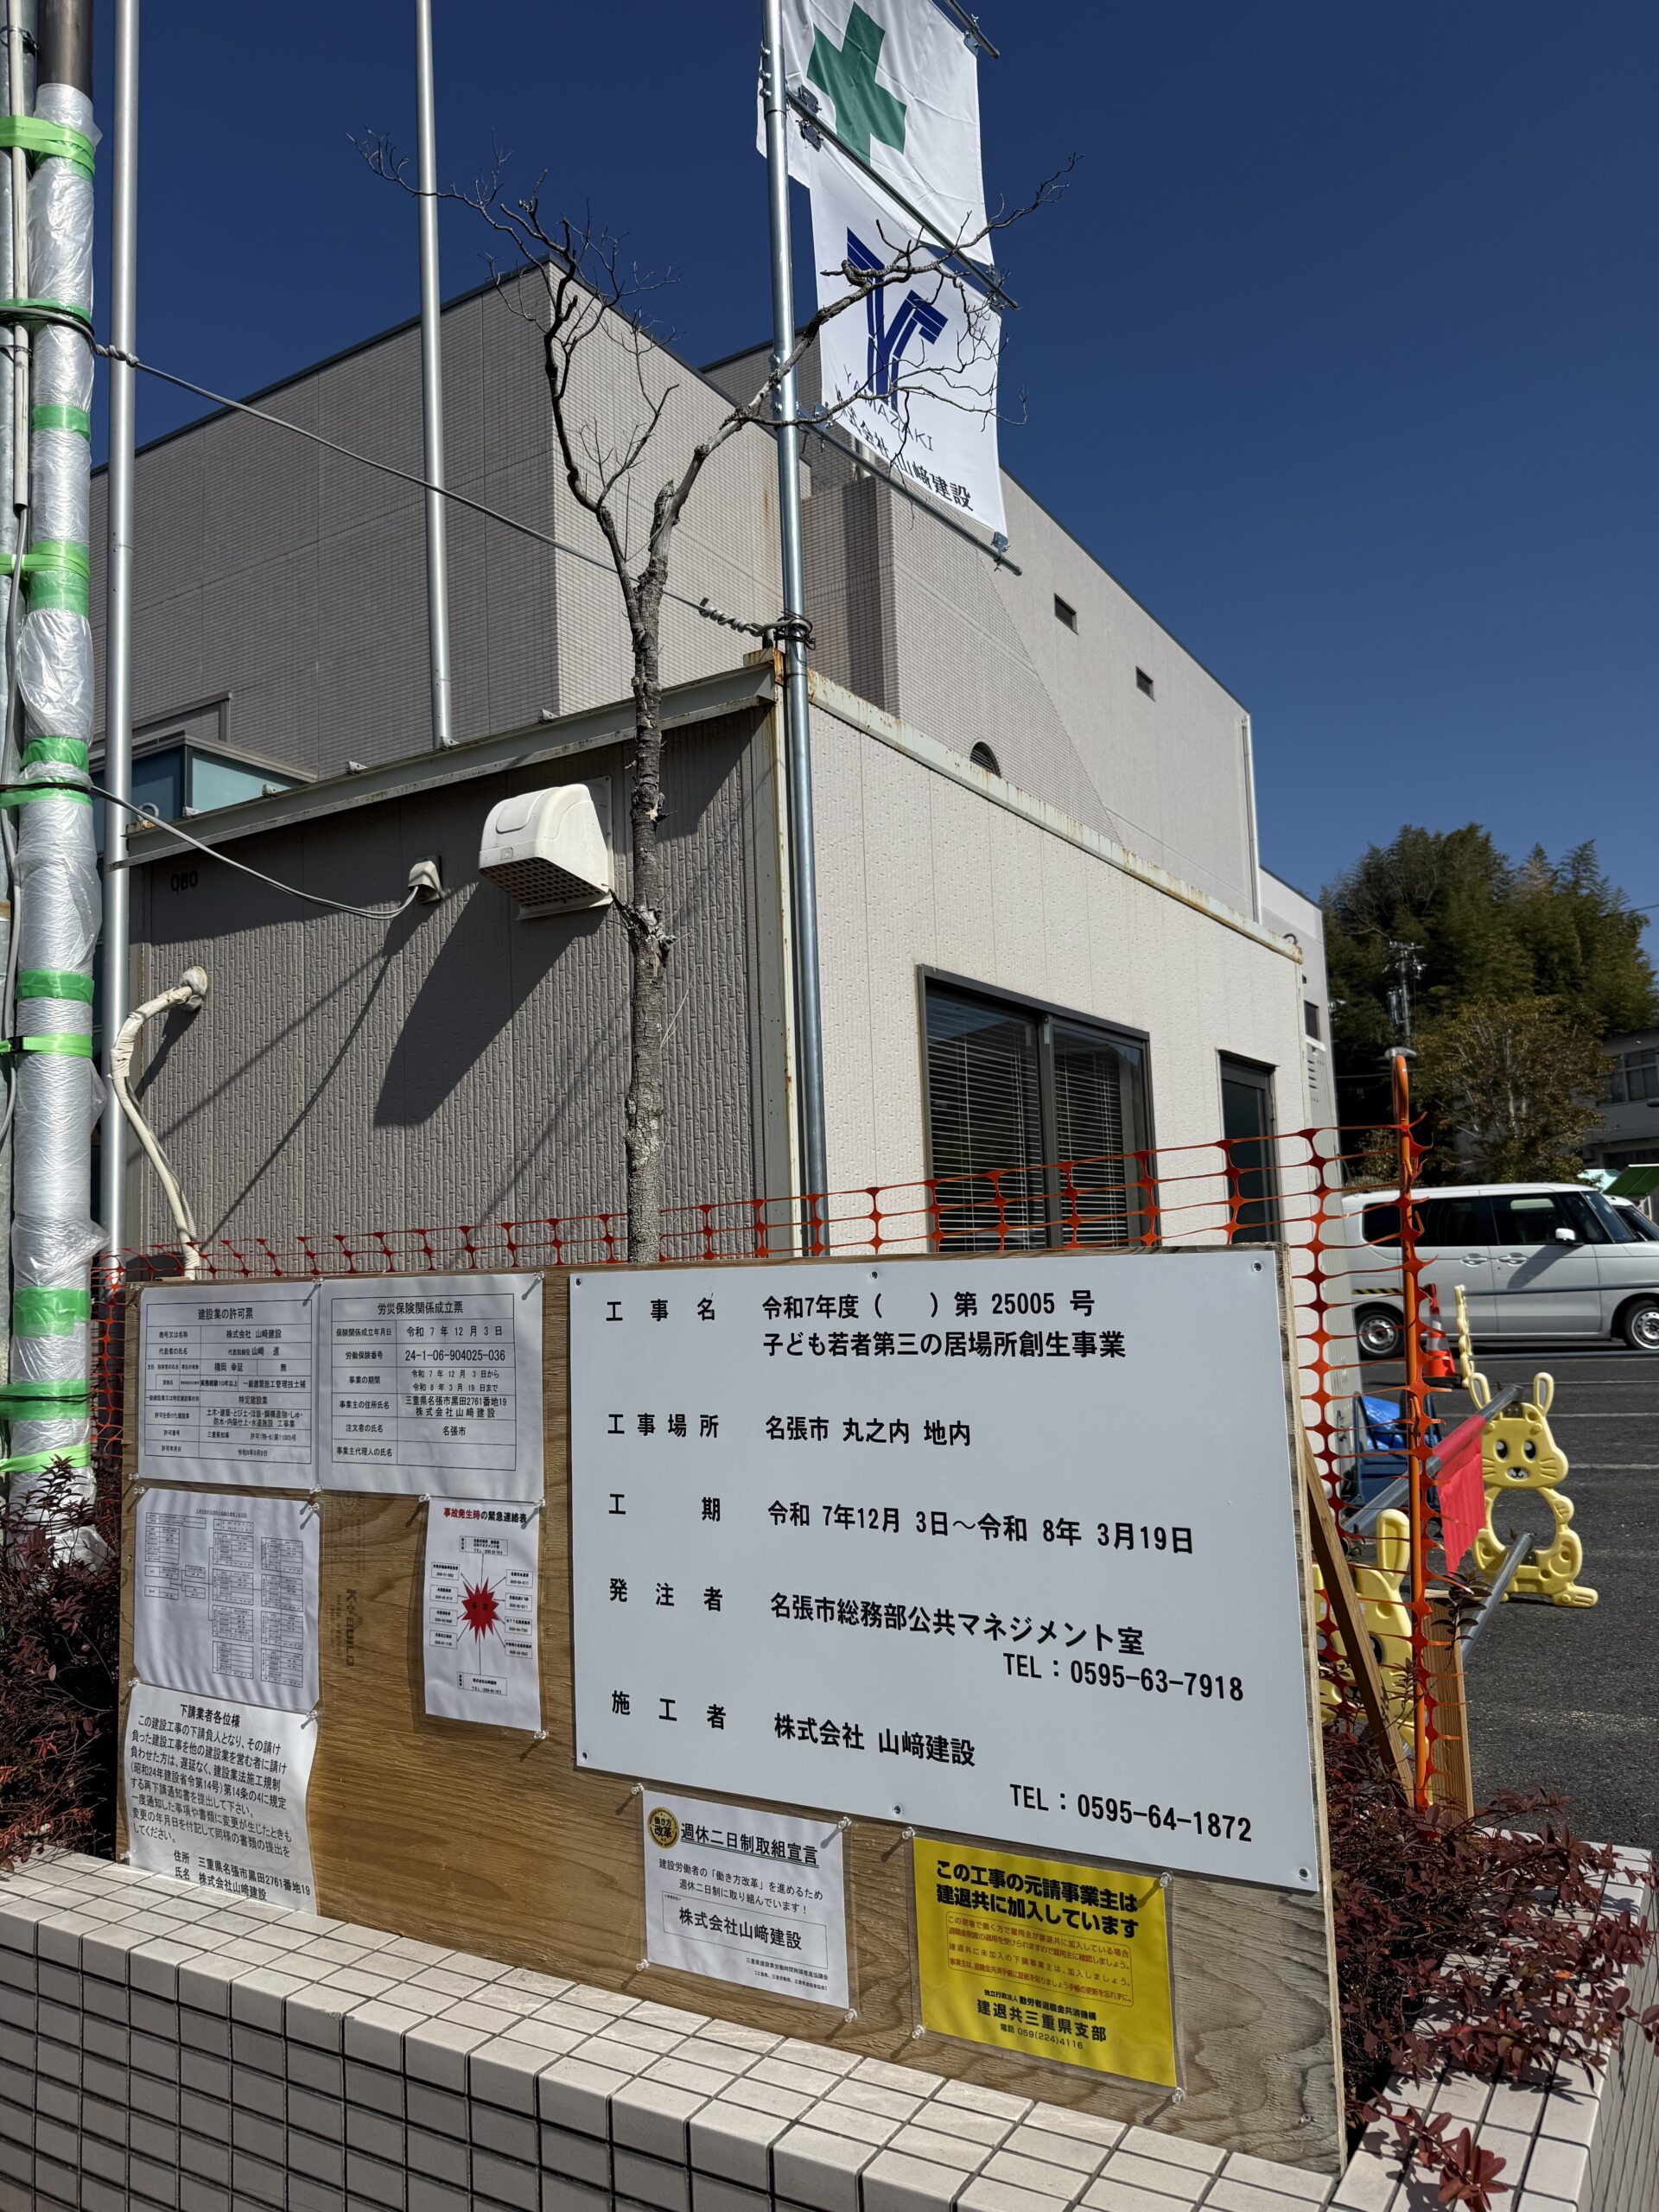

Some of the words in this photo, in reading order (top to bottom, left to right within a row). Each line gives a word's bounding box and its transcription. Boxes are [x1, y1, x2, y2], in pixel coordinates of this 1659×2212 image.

[378, 1300, 463, 1315] 労災保険関係成立票
[991, 1292, 1056, 1314] 25005
[198, 1307, 253, 1320] 建設業の許可票
[226, 1329, 251, 1339] 株式会社
[336, 1328, 391, 1337] 保険関係成立年月日
[763, 1331, 1126, 1357] 子ども若者第三の居場所創生事業
[346, 1351, 383, 1360] 労働保険番号
[405, 1350, 505, 1362] 24-1-06-904025-036
[349, 1376, 380, 1384] 事業の期間
[238, 1395, 268, 1405] 特定建設業
[340, 1401, 390, 1409] 事業主の住所氏名
[405, 1395, 507, 1407] 三重県名張市黒田2761番地19
[346, 1424, 384, 1433] 注文者の氏名
[442, 1426, 467, 1436] 名張市
[766, 1415, 830, 1441] 名張市
[842, 1417, 910, 1445] 丸之内
[923, 1420, 971, 1446] 地内
[336, 1446, 392, 1457] 事業主代理人の氏名
[443, 1507, 527, 1523] 事故発生時の緊急連絡表
[771, 1592, 1145, 1656] 名張市総務部公共マネジメント室
[180, 1704, 241, 1728] 下請業者各位様
[138, 1714, 281, 1756] この建設工事の下請負人となり、その請け
[774, 1713, 865, 1751] 株式会社
[131, 1730, 287, 1775] 負った建設工事を他の建設業を営む者に請け
[131, 1777, 254, 1818] する再下請通知書を提出して下さい。
[131, 1794, 292, 1843] 一度通知した事項や書類に変更が生じたときも
[132, 1808, 290, 1858] 変更の年月日を付記して同様の書類の提出を
[133, 1823, 175, 1843] してください。
[654, 1824, 673, 1838] 改革
[681, 1822, 818, 1865] 週休二日制取組宣言
[174, 1850, 190, 1865] 住所
[198, 1856, 310, 1896] 三重県名張市黒田2761番地19
[175, 1866, 190, 1881] 氏名
[658, 1858, 823, 1900] 建設労働者の「働き方改革」を進めるため
[937, 1860, 1138, 1913] この工事の元請事業主は
[936, 1884, 1139, 1938] 建退共に加入しています
[977, 1999, 1106, 2042] 建退共三重県支部
[1000, 2023, 1015, 2034] 電話
